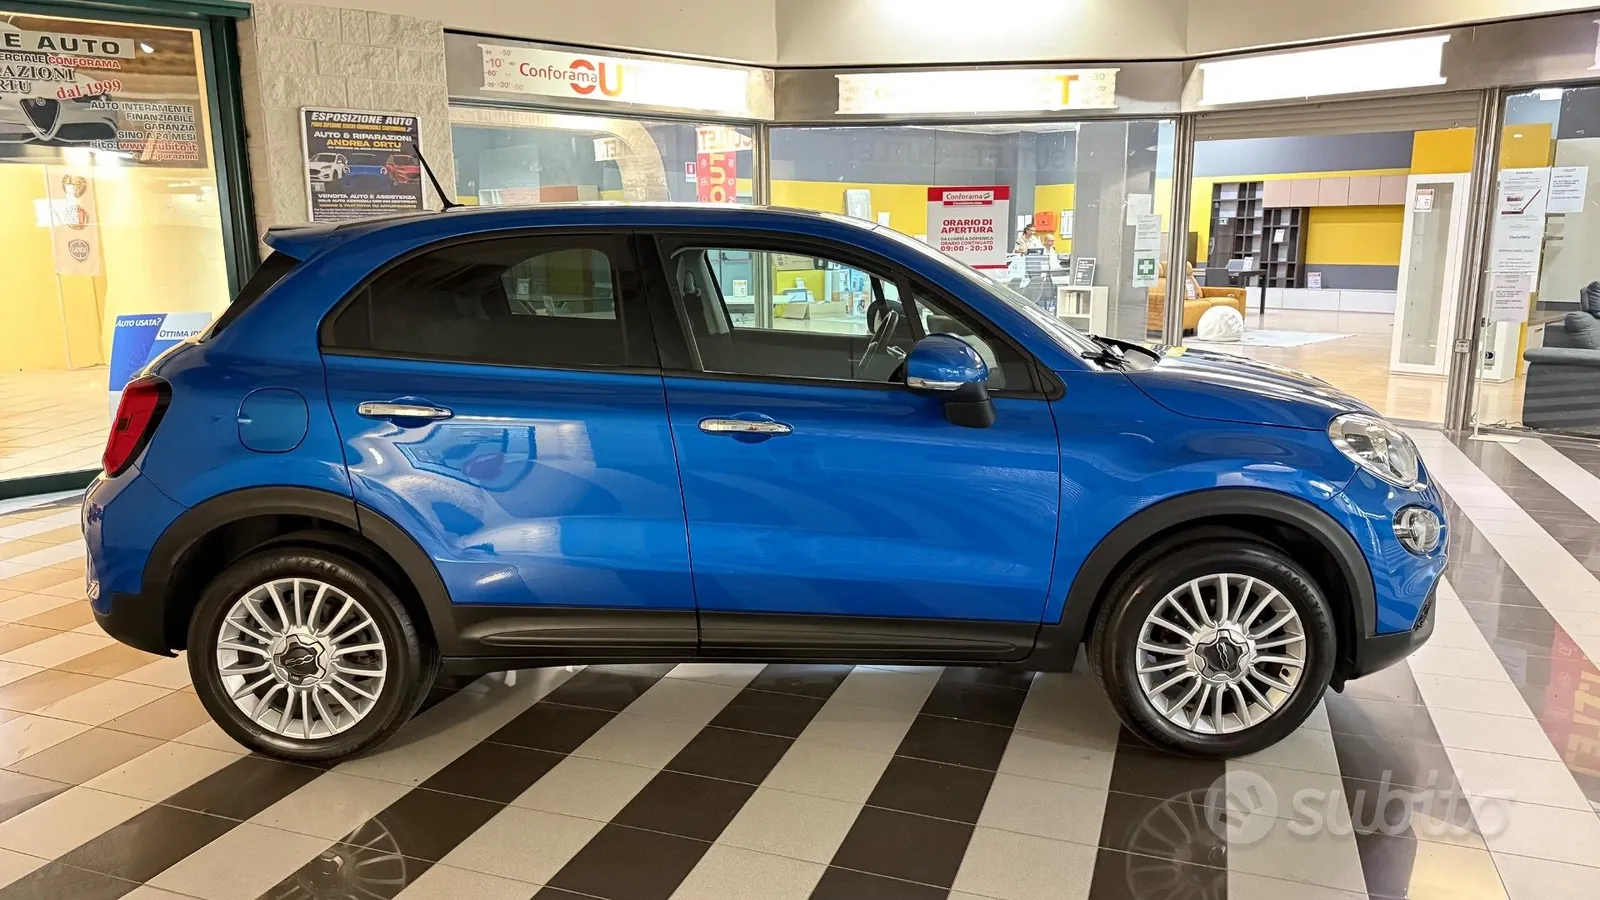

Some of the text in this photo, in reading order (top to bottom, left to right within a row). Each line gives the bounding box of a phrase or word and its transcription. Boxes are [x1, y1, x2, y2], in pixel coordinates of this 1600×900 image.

[37, 35, 120, 55] AUTO
[48, 56, 120, 68] CONFORAMA
[520, 62, 597, 83] Conforama
[57, 80, 121, 99] dal 1999
[91, 101, 193, 113] AUTO INTERAMENTE
[126, 112, 194, 123] FINANZIABILE
[311, 112, 413, 126] ESPOSIZIONE AUTO
[144, 123, 195, 132] GARANZIA
[118, 131, 143, 139] SINO
[172, 133, 196, 141] MESI
[314, 131, 341, 139] AUTO
[352, 132, 412, 142] RIPARAZIONI
[90, 140, 117, 151] sito:
[326, 139, 370, 147] ANDREA
[372, 141, 401, 149] ORTU
[946, 193, 983, 201] Conforama
[941, 226, 994, 234] APERTURA
[116, 317, 162, 328] AUTO USATA?
[159, 329, 189, 339] OTTIMA
